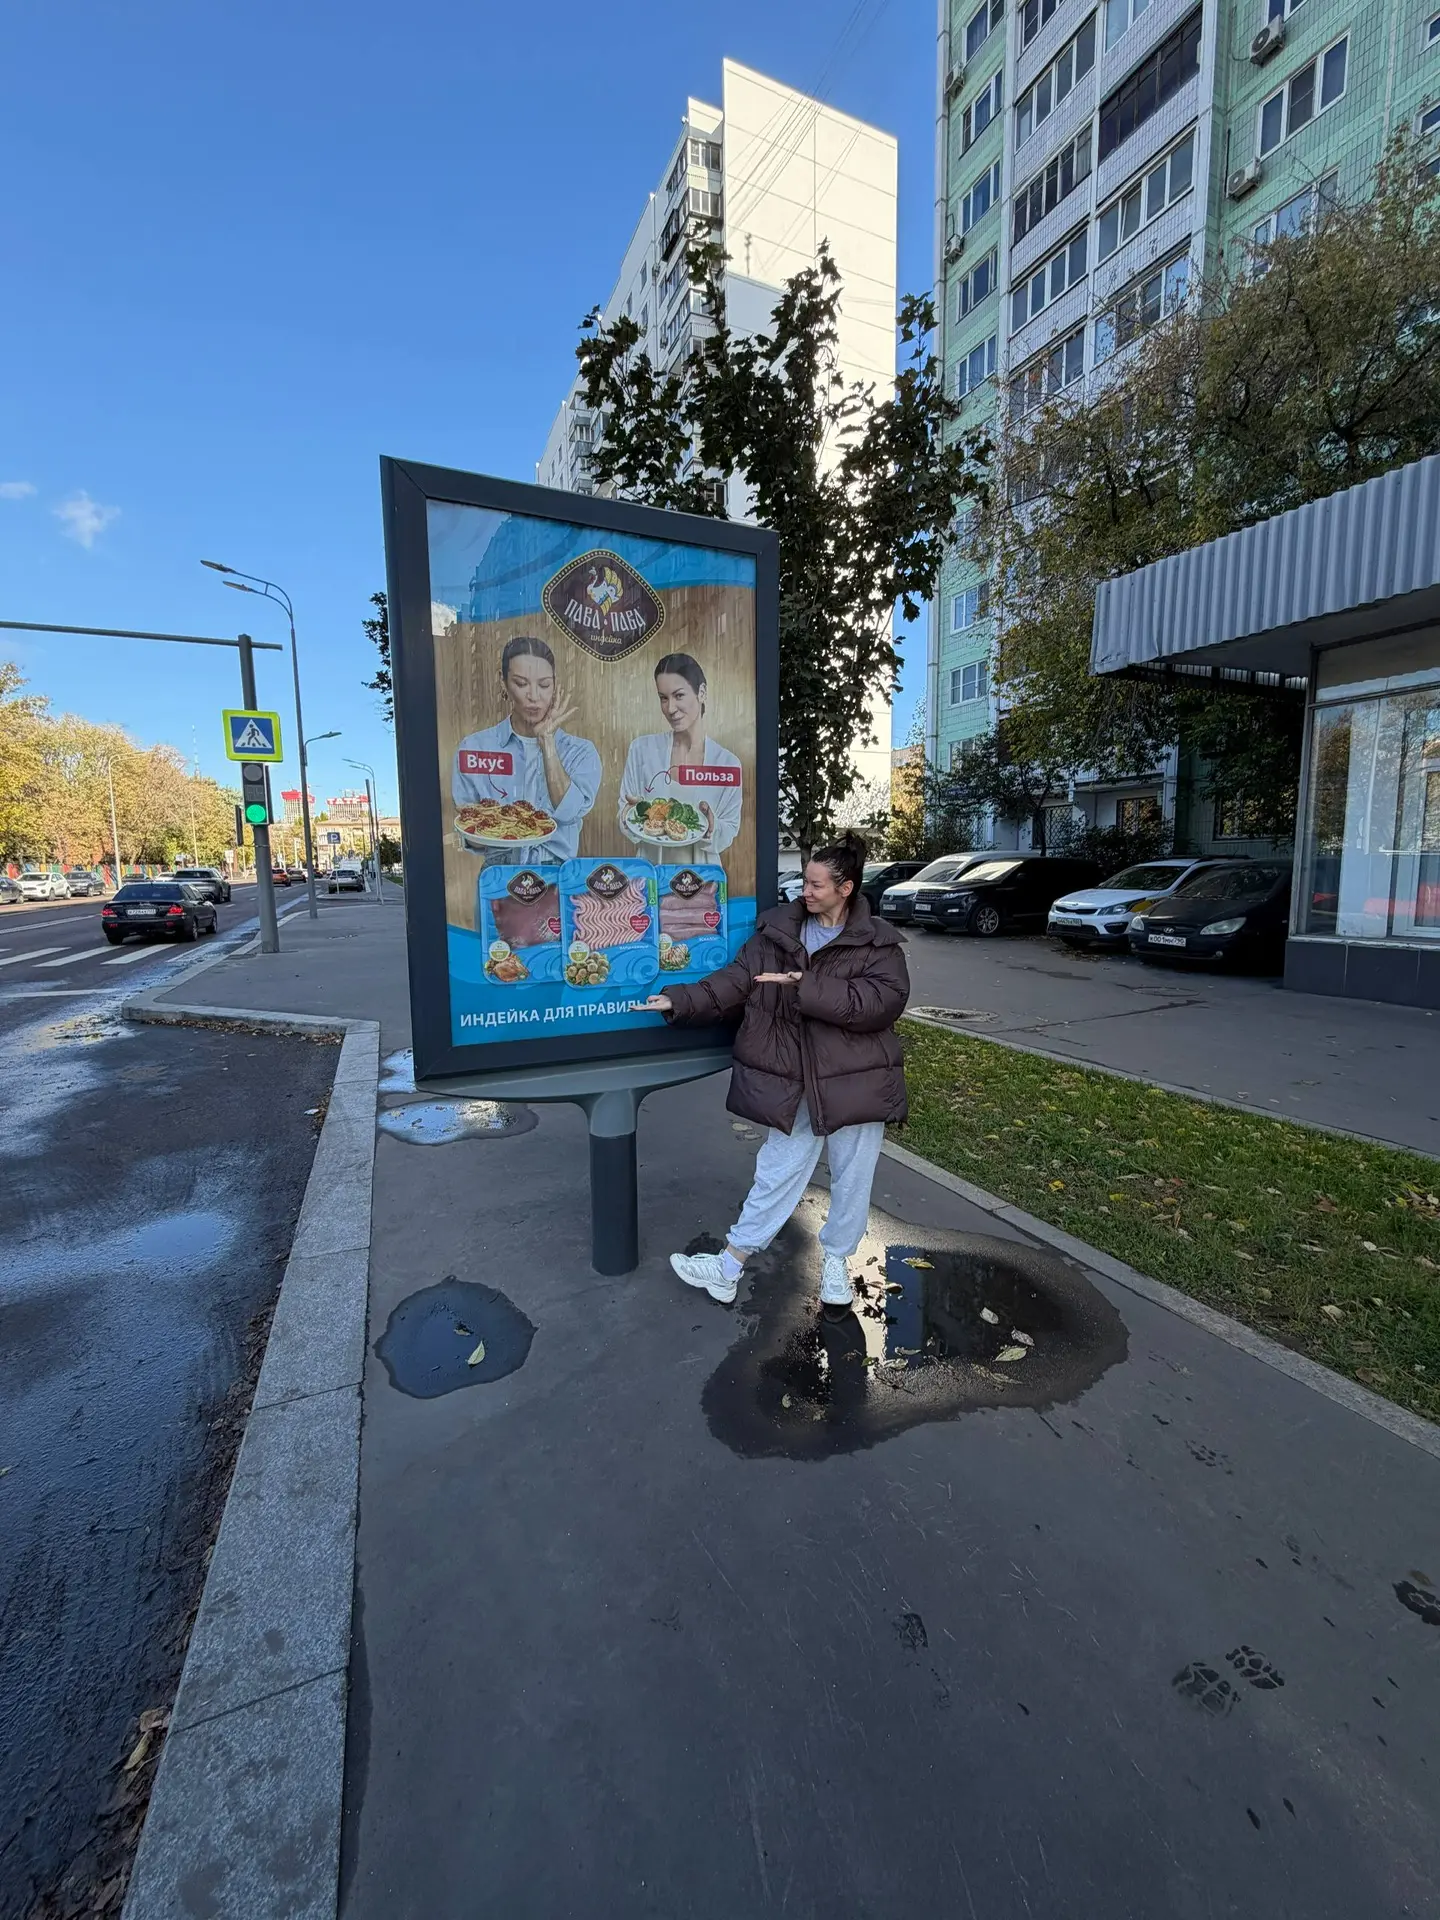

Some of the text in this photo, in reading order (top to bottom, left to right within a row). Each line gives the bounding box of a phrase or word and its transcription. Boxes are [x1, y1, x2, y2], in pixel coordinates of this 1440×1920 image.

[564, 599, 646, 632] ПАВА ПАВА
[467, 753, 505, 773] Вкус
[685, 768, 734, 783] Польза
[460, 1008, 540, 1028] ИНДЕЙКА
[543, 1006, 574, 1023] ДЛЯ
